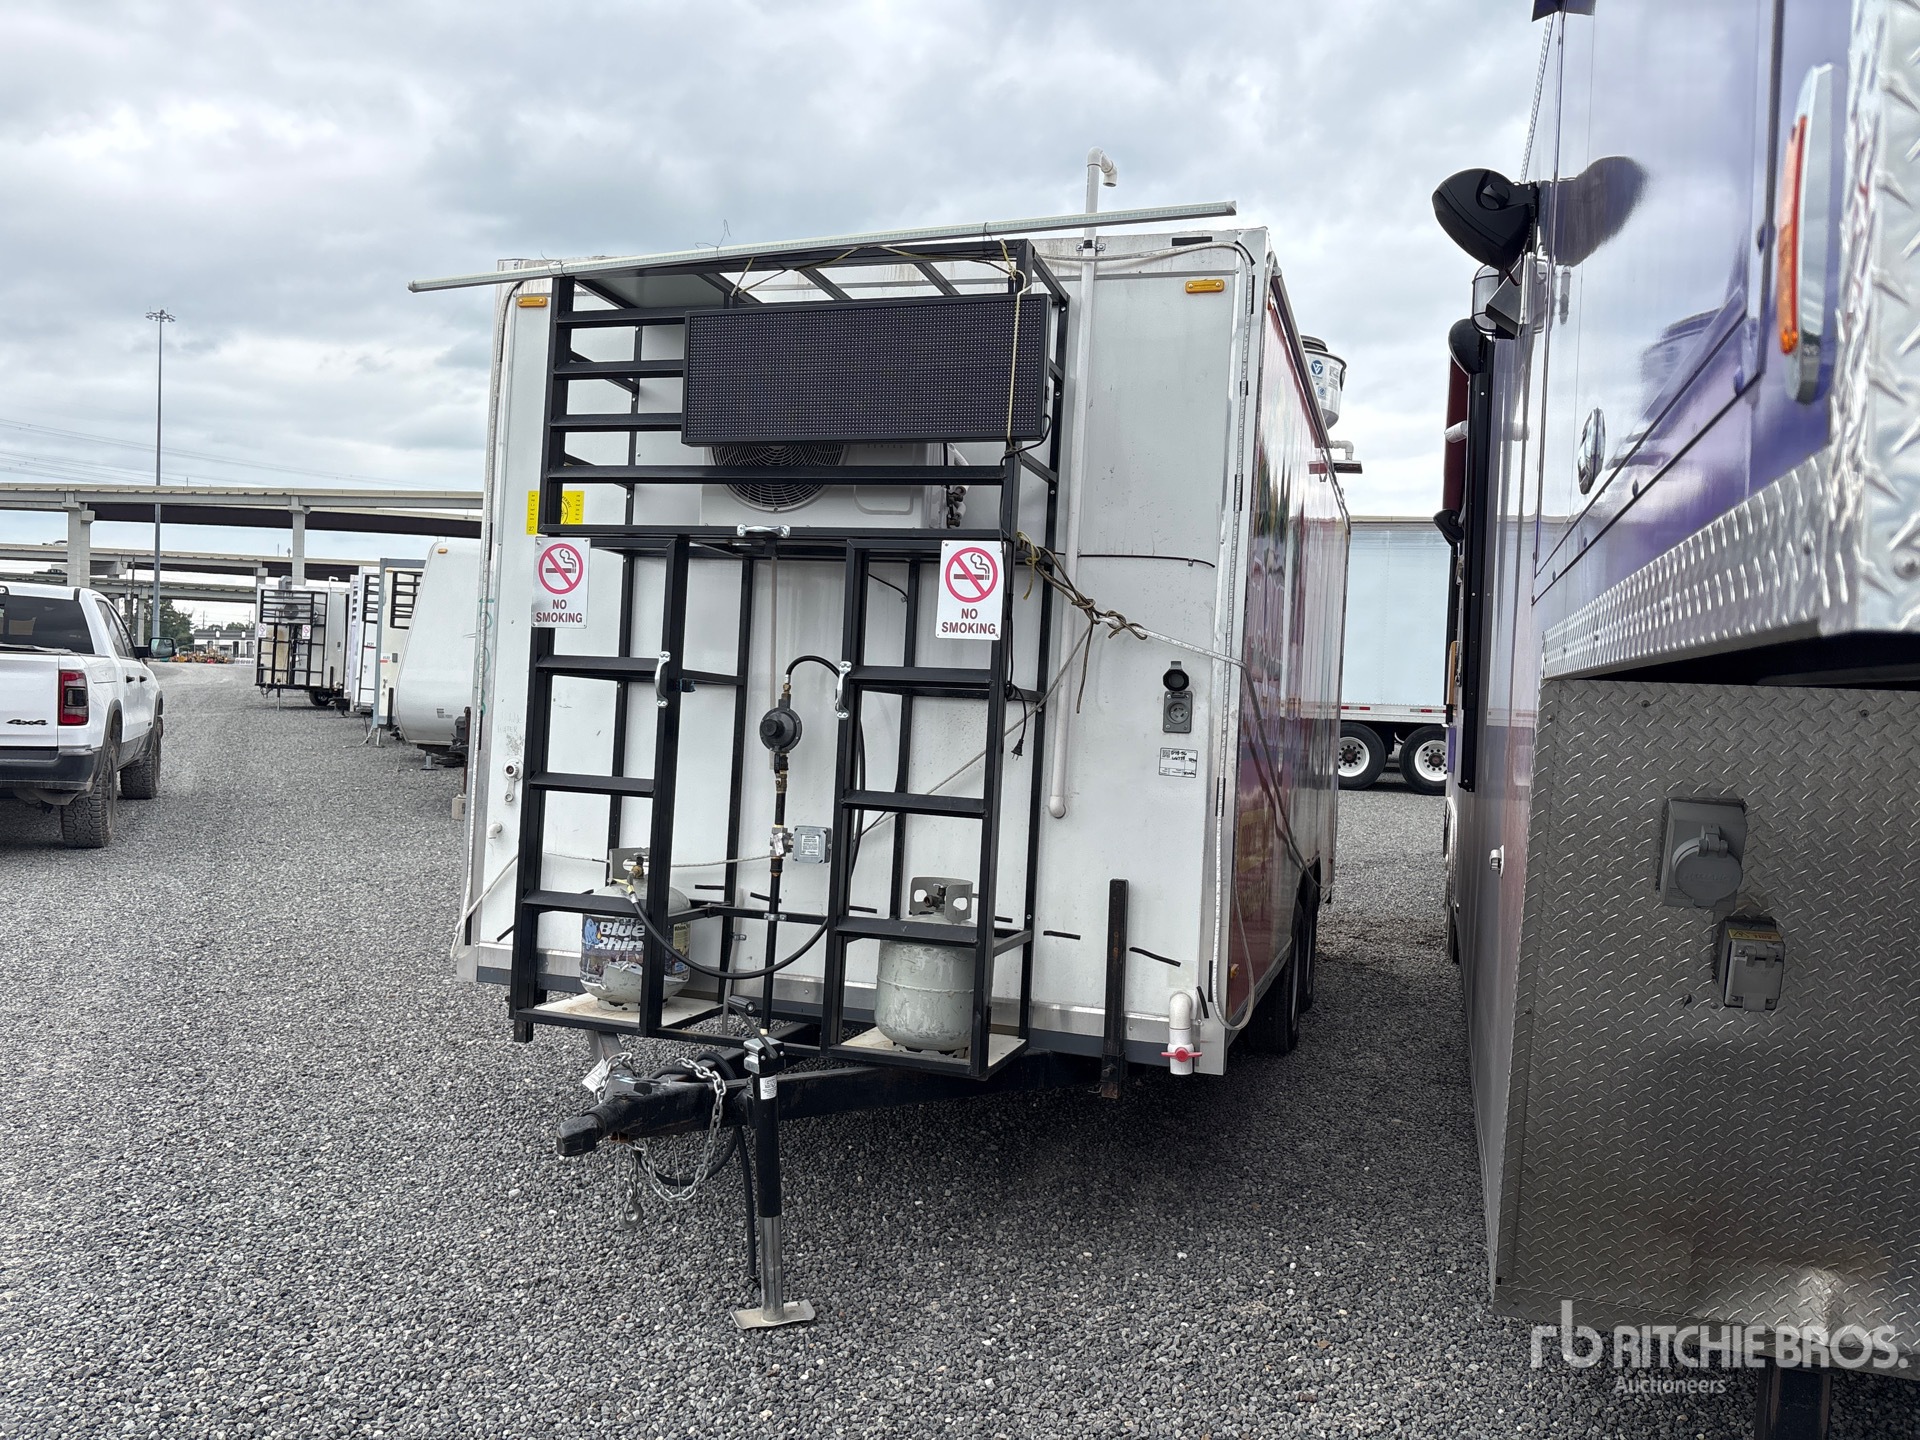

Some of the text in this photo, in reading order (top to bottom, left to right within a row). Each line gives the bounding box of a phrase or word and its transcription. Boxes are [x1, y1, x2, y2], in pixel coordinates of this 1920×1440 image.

[552, 599, 567, 609] NO
[536, 612, 583, 623] SMOKING
[961, 608, 978, 620] NO
[941, 621, 996, 634] SMOKING
[600, 921, 646, 937] Blue
[595, 937, 645, 952] Rhin
